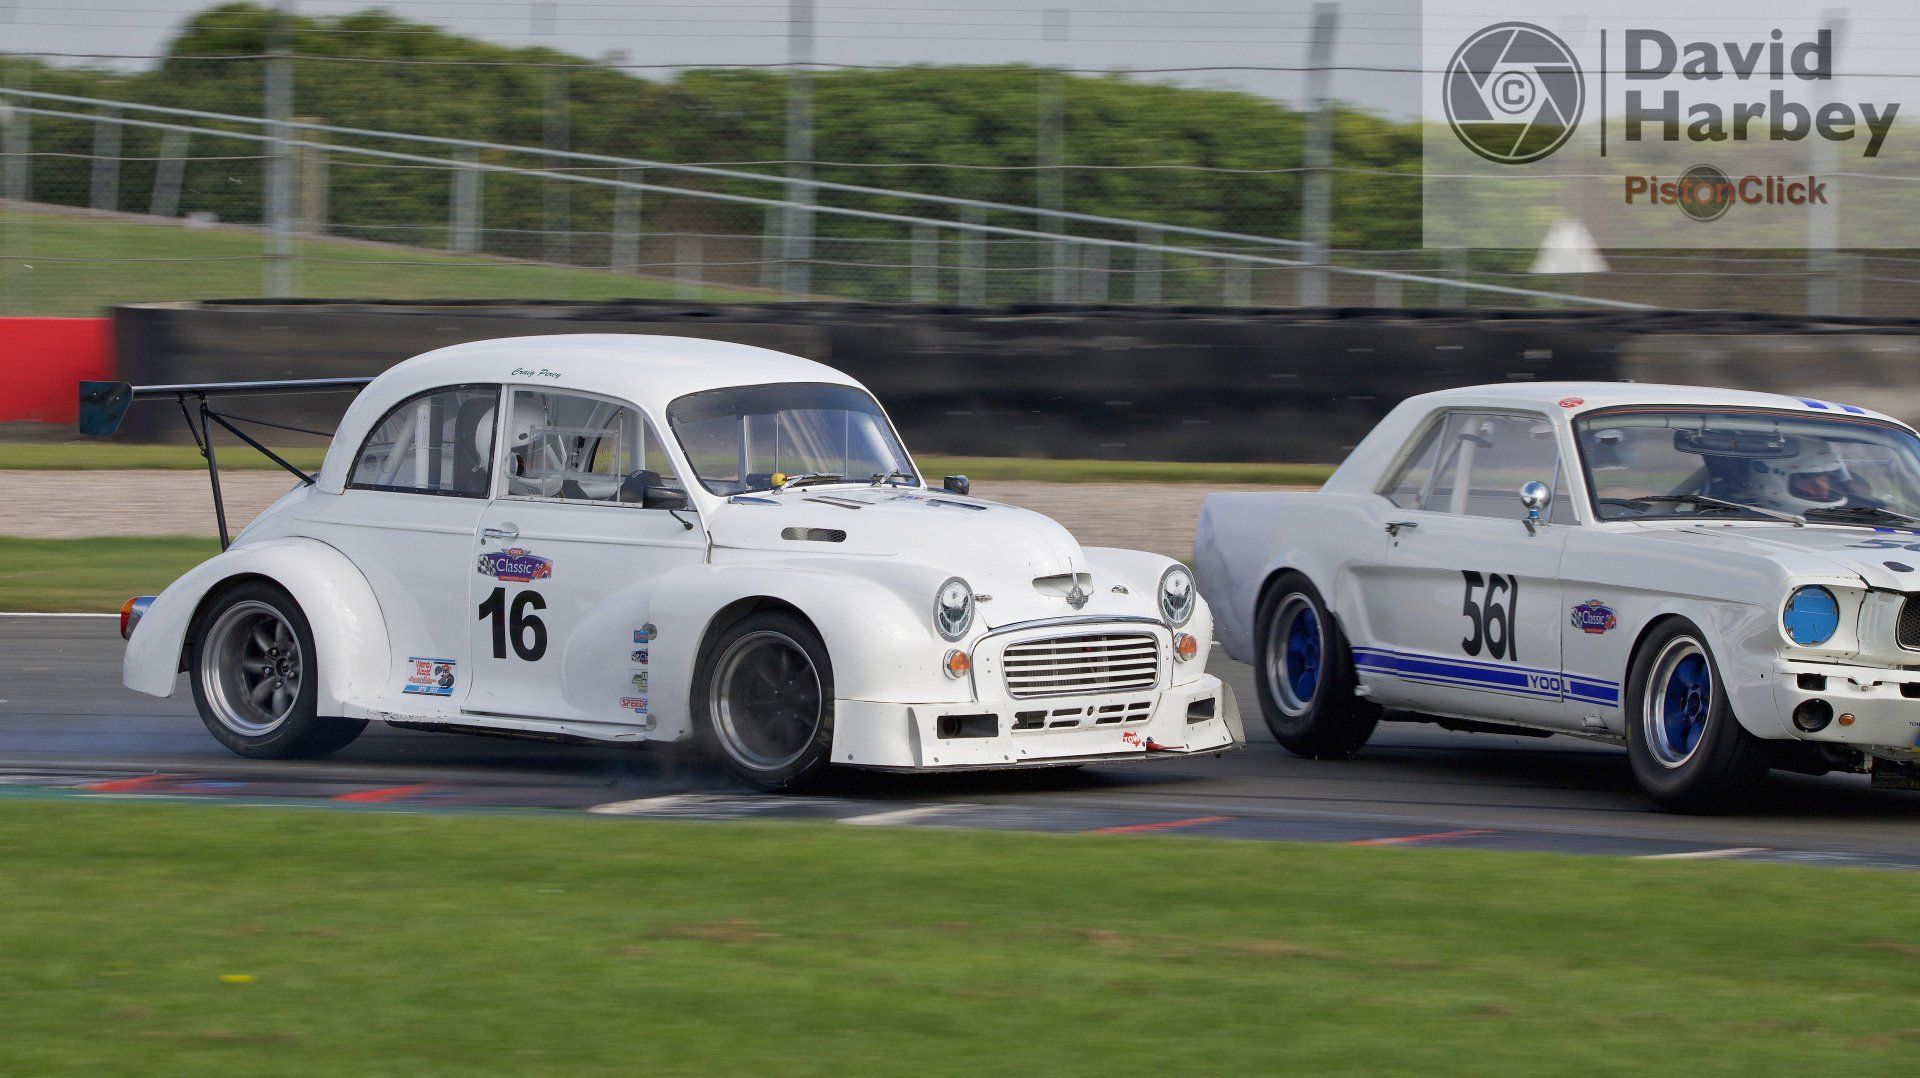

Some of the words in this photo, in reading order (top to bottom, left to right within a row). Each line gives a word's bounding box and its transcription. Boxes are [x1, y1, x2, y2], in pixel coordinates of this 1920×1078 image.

[511, 367, 535, 378] Craig
[496, 558, 532, 574] Classic
[1461, 569, 1518, 662] 561
[1582, 610, 1605, 625] Classic
[478, 587, 548, 662] 16
[1529, 674, 1570, 694] YOOL
[1122, 733, 1141, 744] TOW
